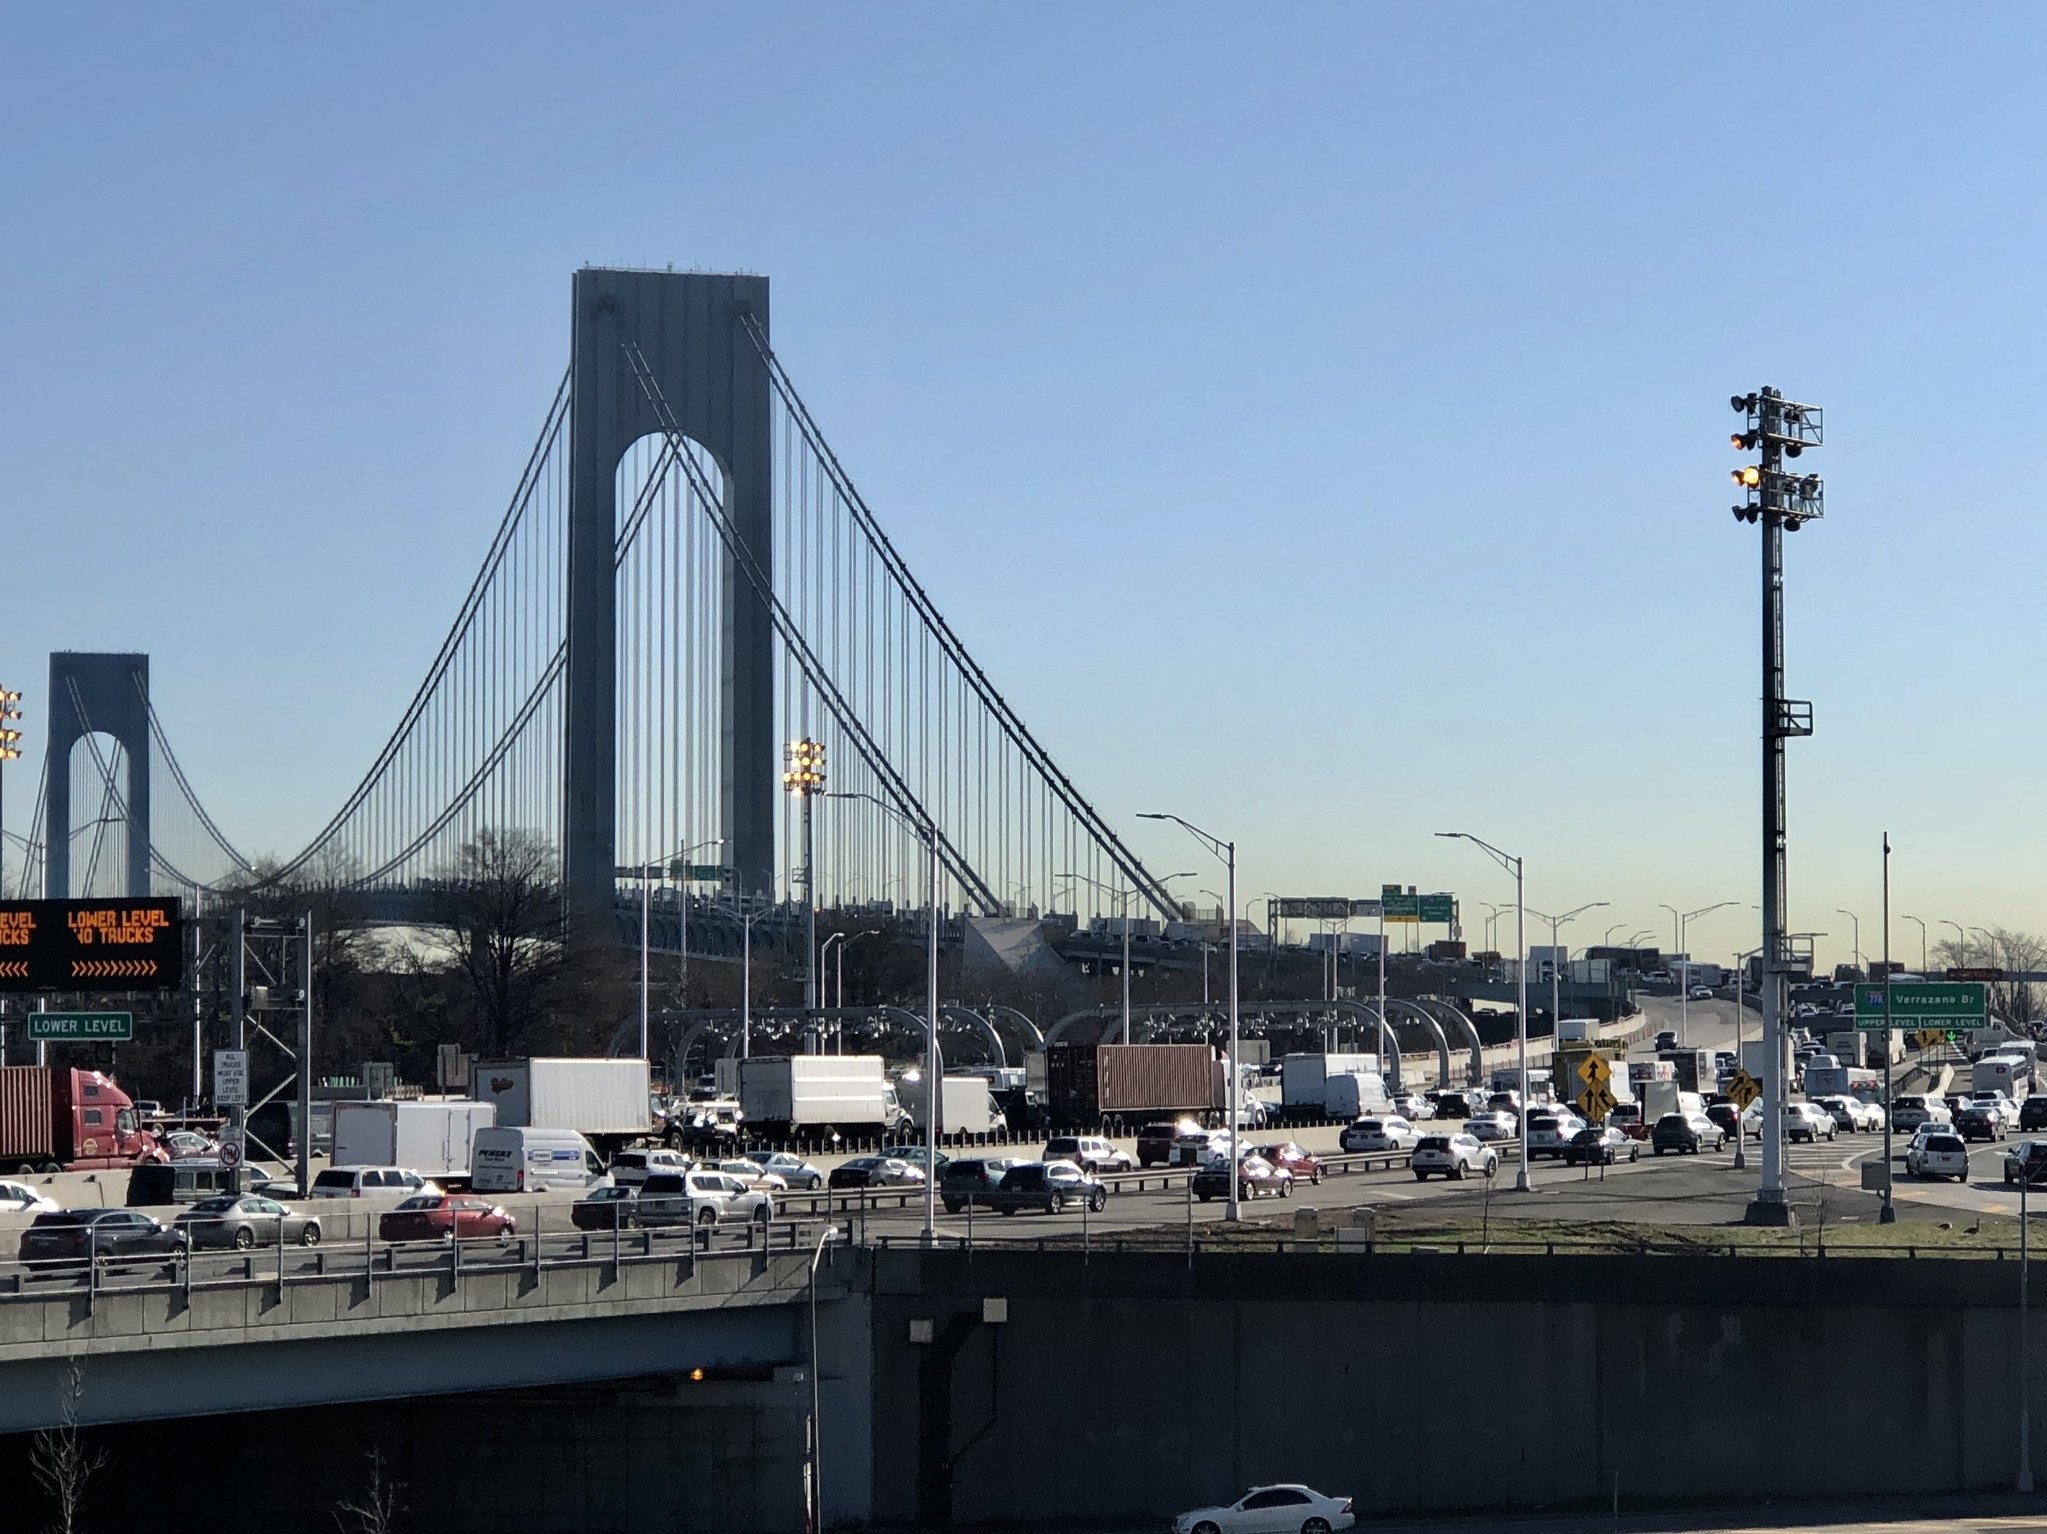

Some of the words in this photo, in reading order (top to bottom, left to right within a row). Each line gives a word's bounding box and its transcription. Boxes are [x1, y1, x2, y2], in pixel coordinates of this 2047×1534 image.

[68, 910, 116, 928] LOWER
[122, 909, 169, 927] LEVEL
[0, 928, 29, 945] CKS
[99, 927, 154, 944] TRUCKS
[1896, 994, 1955, 1004] Verrazano
[1961, 994, 1974, 1004] Br
[34, 1019, 77, 1033] LOWER
[84, 1019, 126, 1033] LEVEL
[1858, 1019, 1886, 1027] UPPER
[1890, 1019, 1916, 1027] LEVEL
[1923, 1018, 1951, 1027] LOWER
[1954, 1018, 1981, 1027] LEVEL
